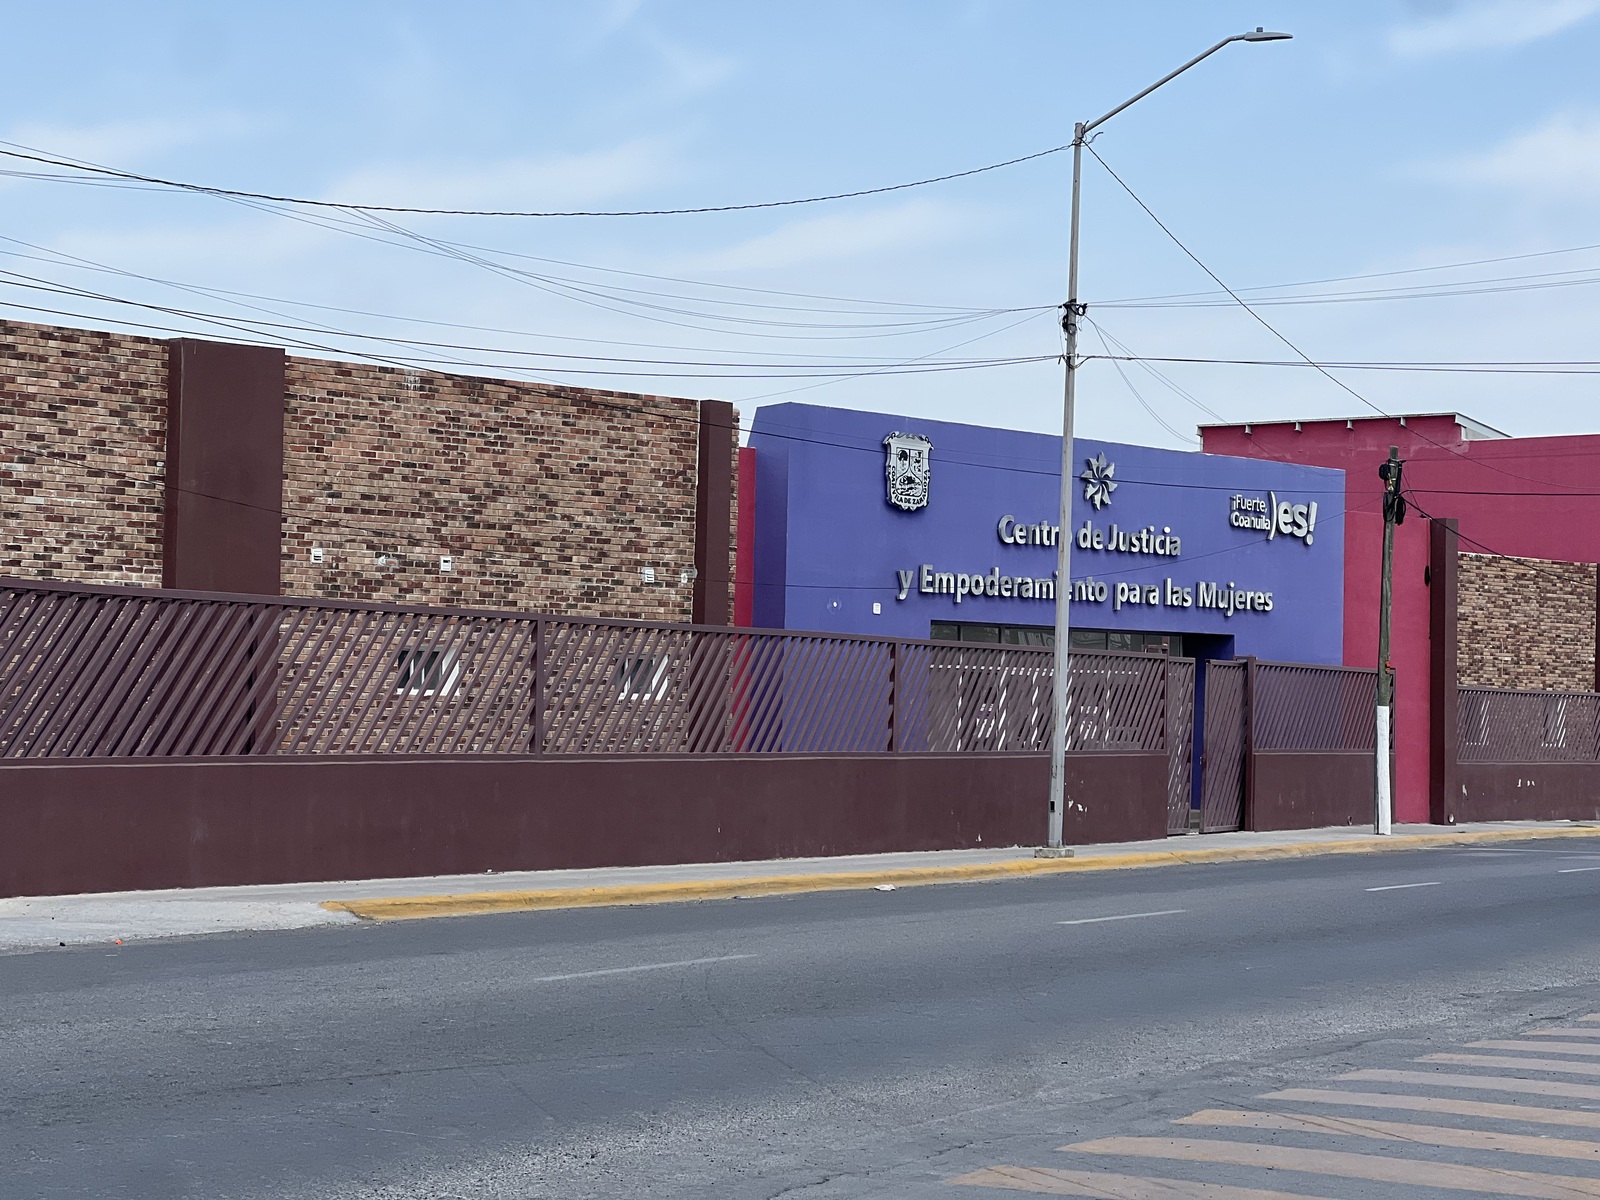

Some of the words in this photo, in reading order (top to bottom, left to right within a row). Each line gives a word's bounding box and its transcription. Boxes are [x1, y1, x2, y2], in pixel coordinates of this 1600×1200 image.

[998, 514, 1073, 546] Centr
[1078, 520, 1104, 549] de
[1106, 523, 1181, 556] Justicia
[1231, 511, 1270, 530] Coahuila
[896, 569, 914, 600] y
[919, 564, 1108, 603] Empoderamnto
[1114, 581, 1160, 611] para
[1164, 577, 1193, 607] las
[1196, 581, 1274, 617] Mujeres
